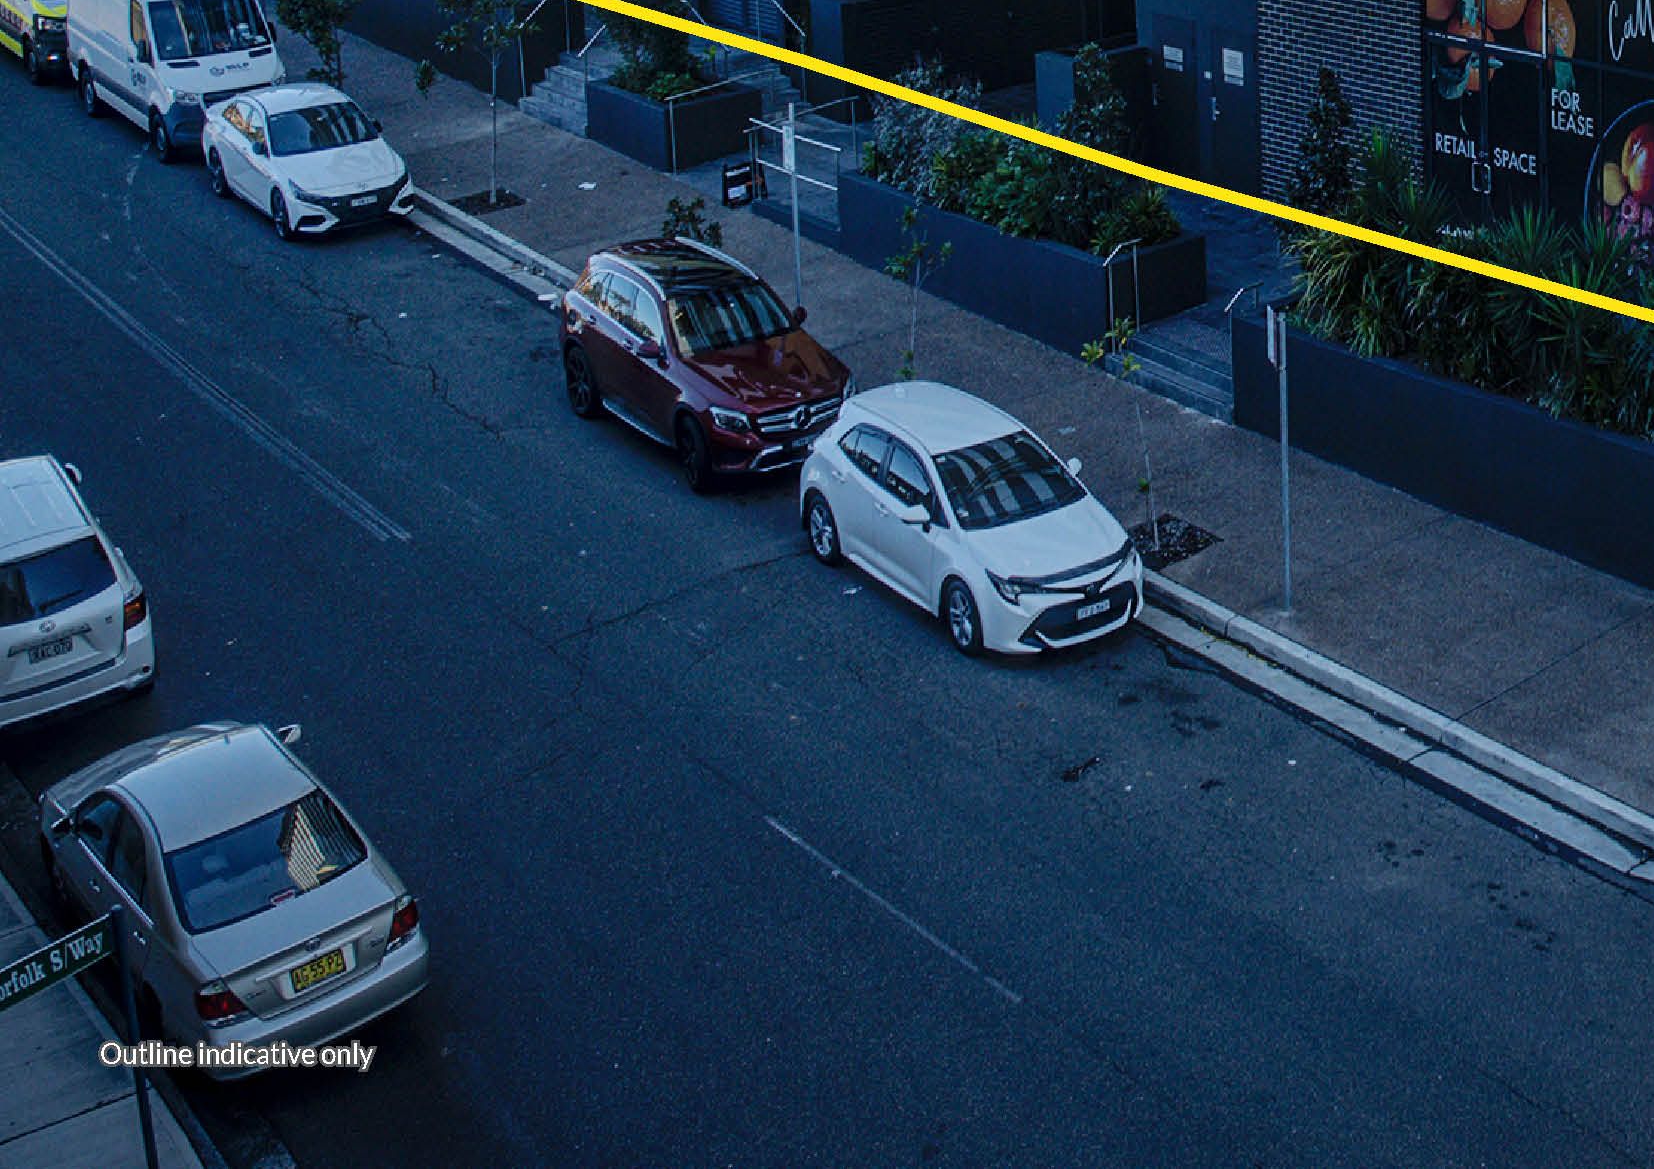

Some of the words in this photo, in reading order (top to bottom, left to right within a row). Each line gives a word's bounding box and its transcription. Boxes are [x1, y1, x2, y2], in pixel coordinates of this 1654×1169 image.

[1551, 88, 1580, 112] FOR
[1551, 110, 1594, 137] LEASE
[1434, 132, 1476, 159] RETAIL
[1493, 147, 1537, 175] SPACE
